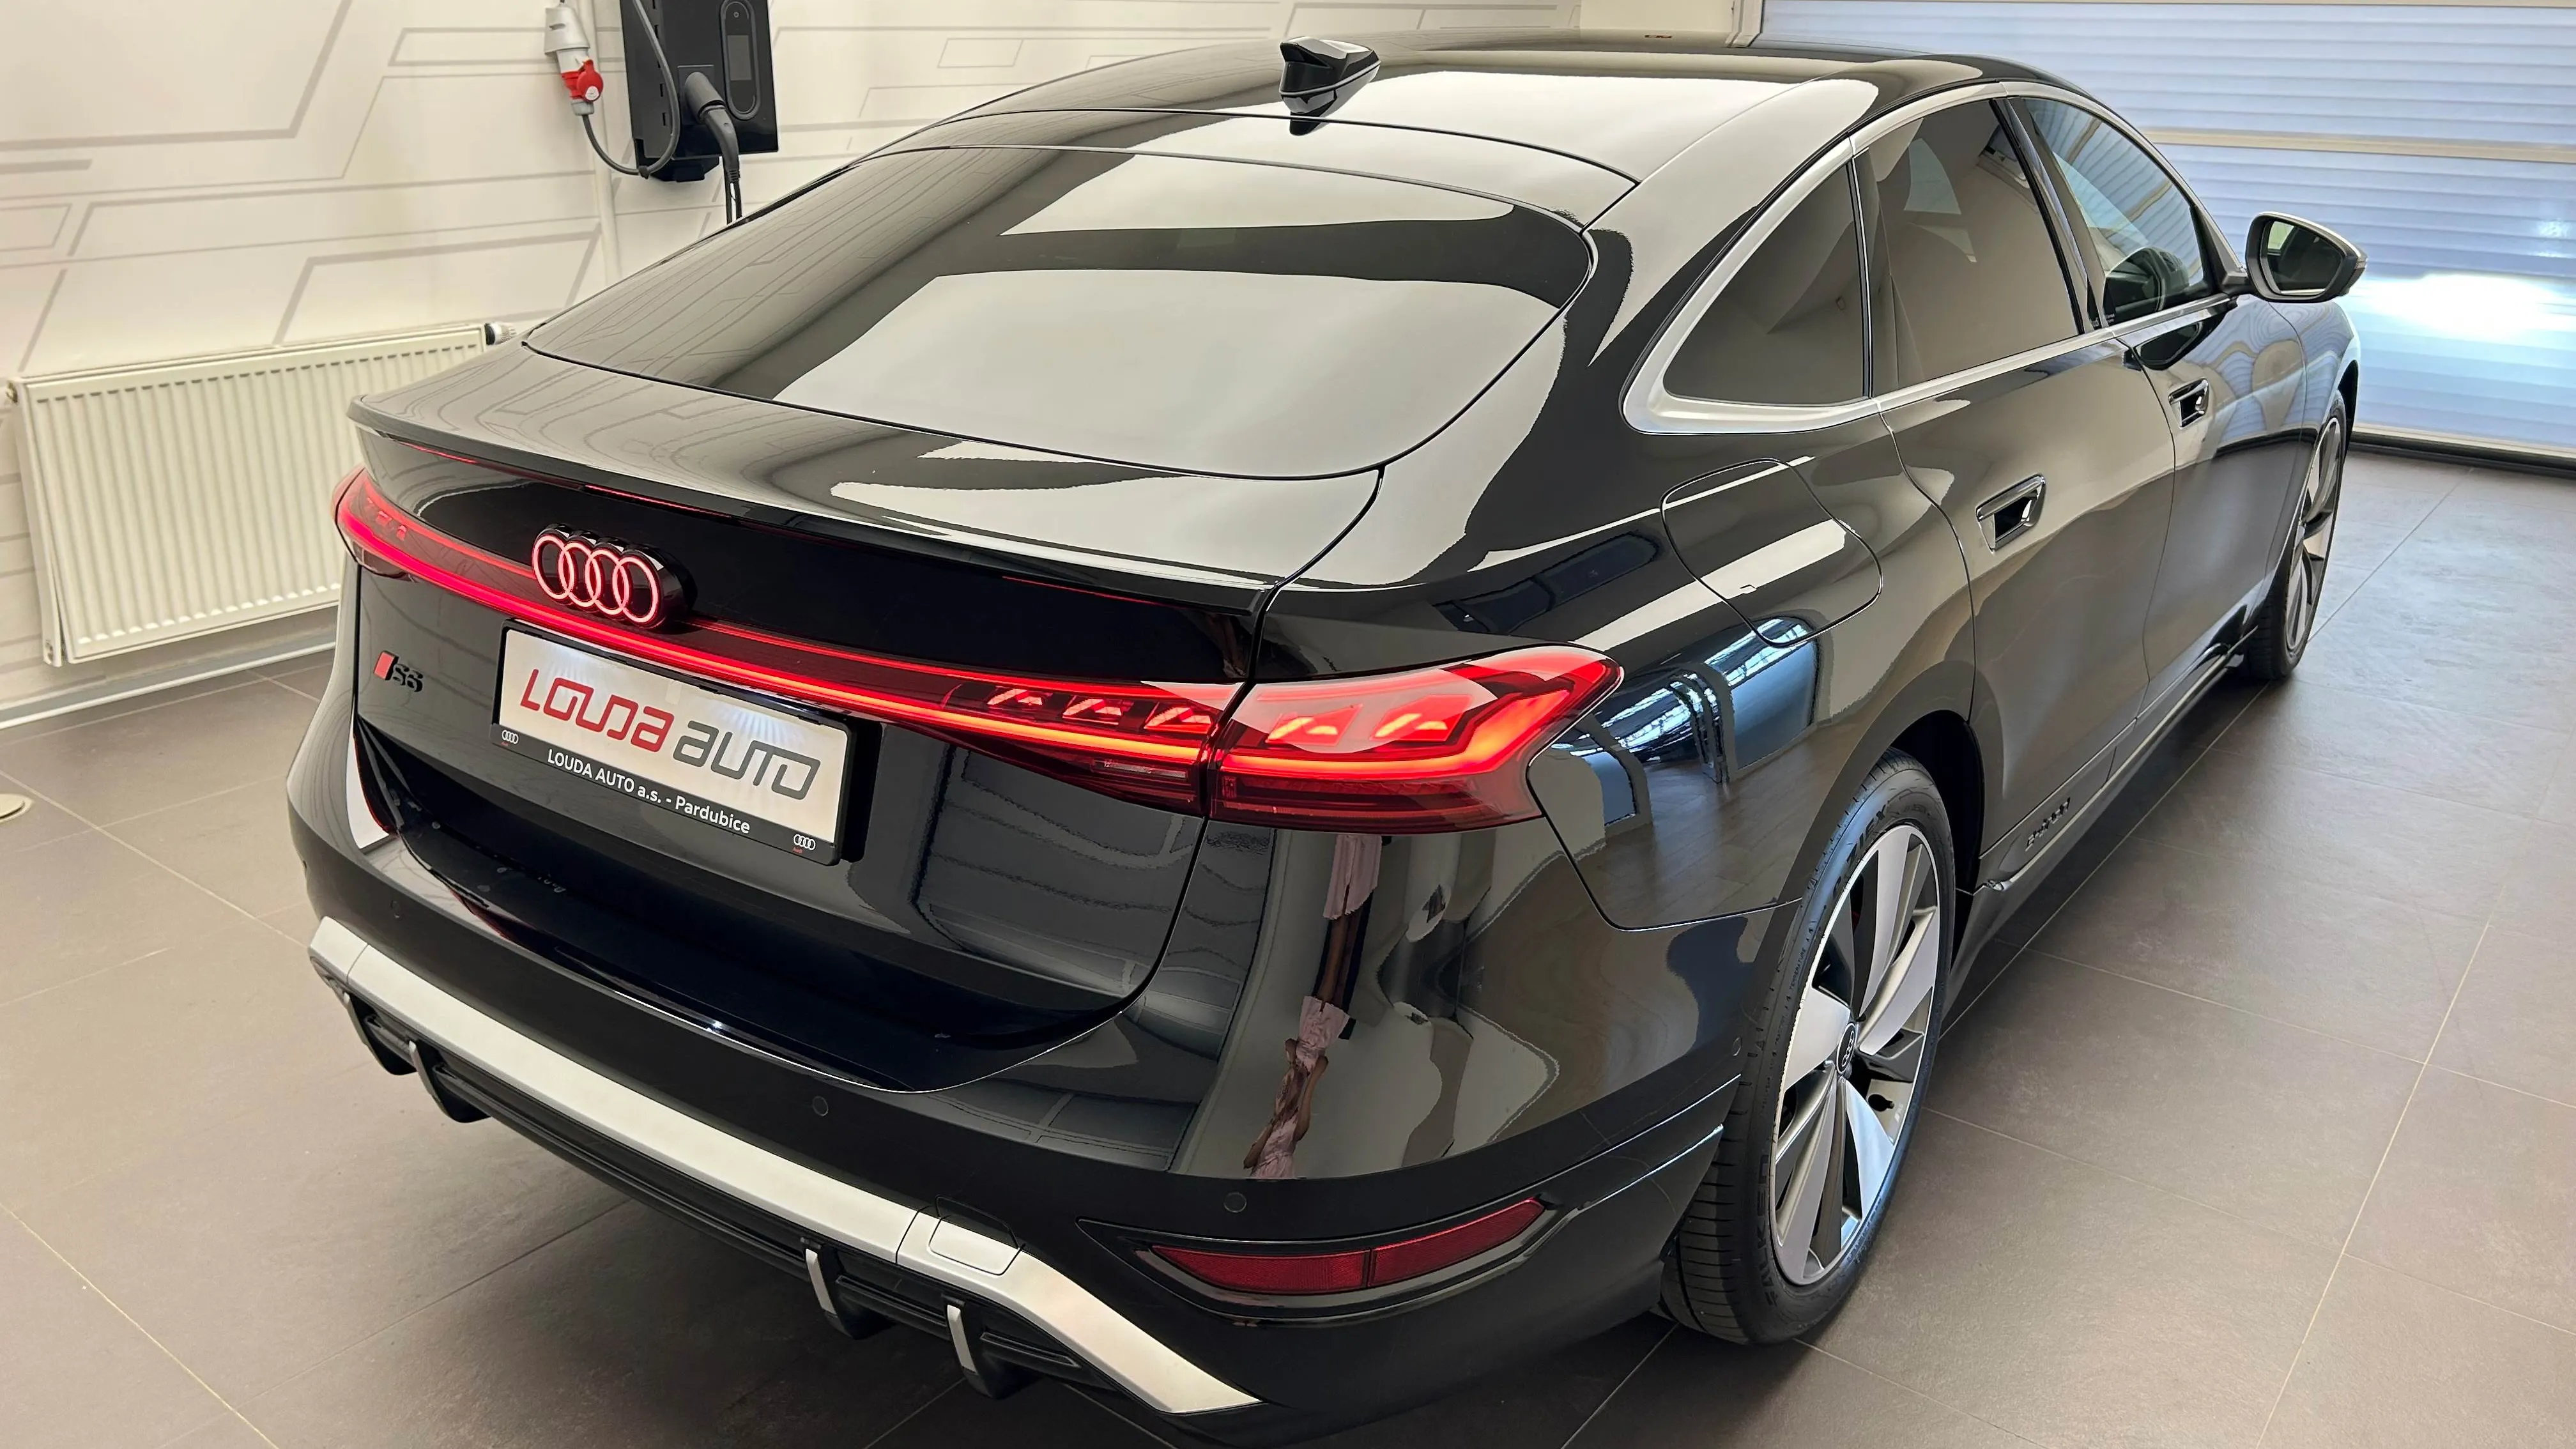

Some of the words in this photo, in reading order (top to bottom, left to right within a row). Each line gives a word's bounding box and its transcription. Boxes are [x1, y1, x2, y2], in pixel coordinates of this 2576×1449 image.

[391, 663, 424, 693] S6
[547, 748, 593, 778] LOUDA
[595, 771, 635, 792] AUTO
[637, 786, 661, 804] a.s.
[675, 795, 751, 834] Pardubice
